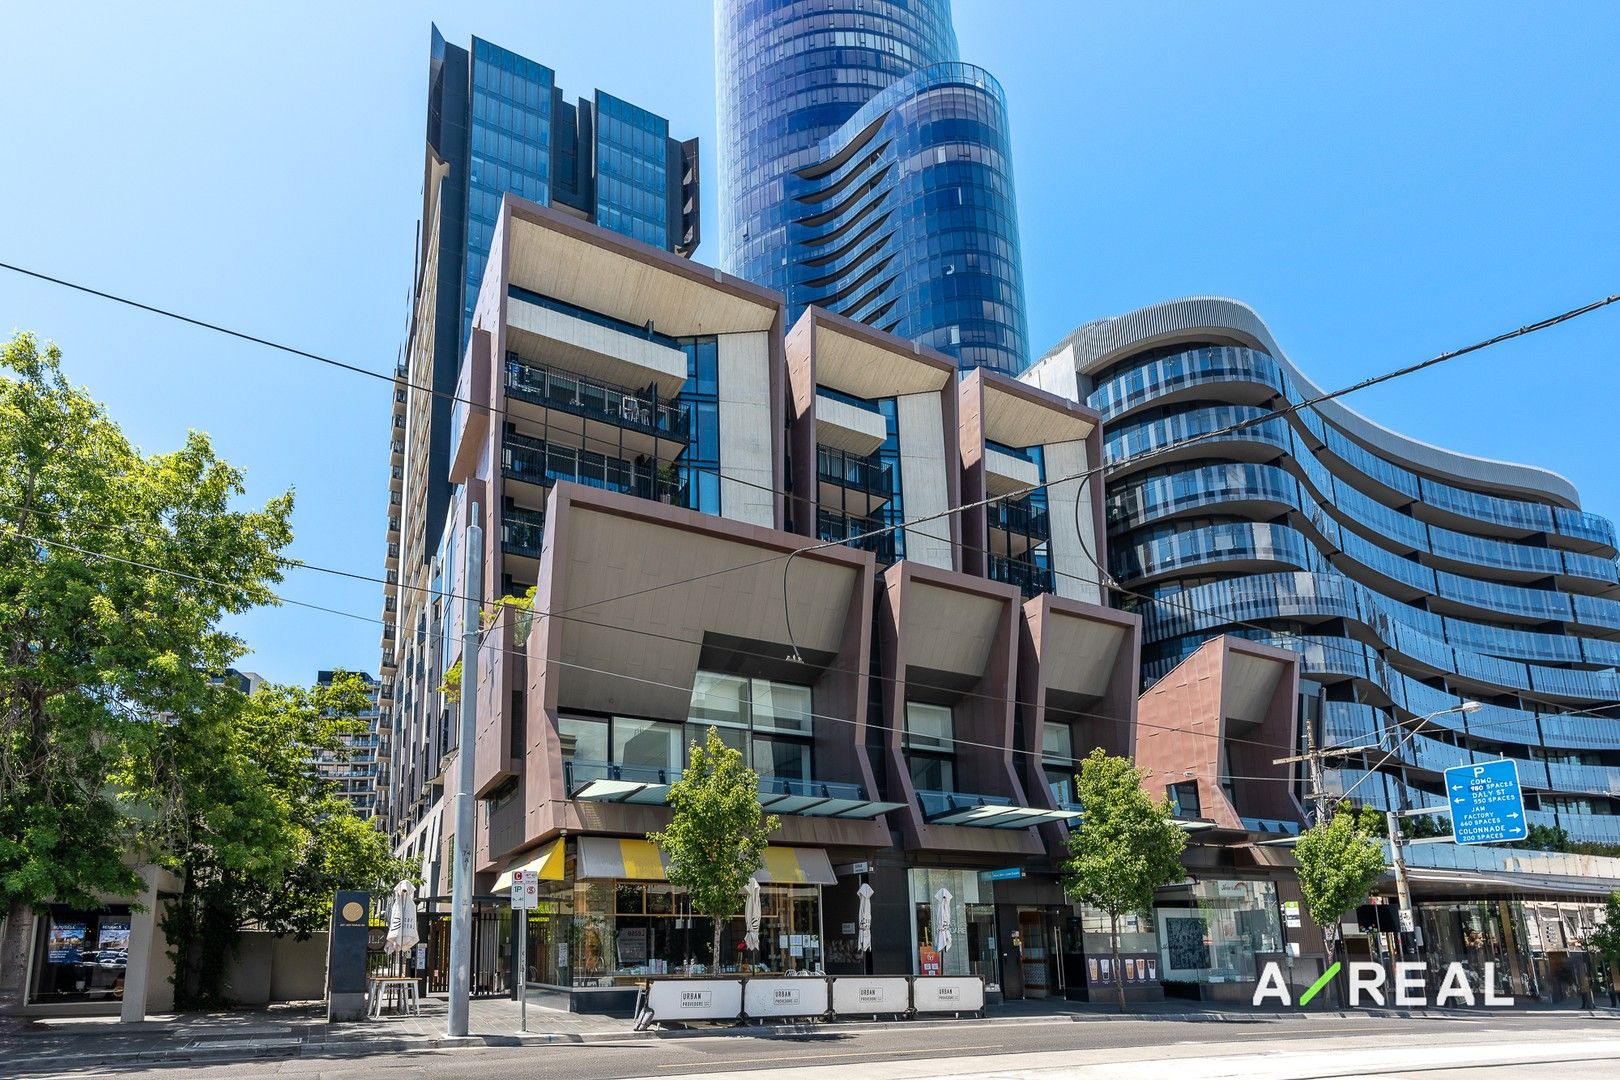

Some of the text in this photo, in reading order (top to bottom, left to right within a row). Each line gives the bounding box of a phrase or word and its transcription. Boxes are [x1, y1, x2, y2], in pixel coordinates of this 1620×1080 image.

[1473, 767, 1485, 778] P
[1470, 777, 1492, 786] COMO
[1486, 781, 1514, 790] SPACES
[1472, 790, 1493, 799] DALY
[1473, 794, 1516, 805] 550 SPACES
[1464, 812, 1494, 820] FACTORY
[1474, 817, 1501, 826] SPACES
[1458, 824, 1506, 835] COLONNADE
[1462, 832, 1504, 841] 200 SPACES
[514, 885, 522, 893] 1P
[682, 992, 702, 1000] URBAN
[775, 990, 792, 998] URBAN
